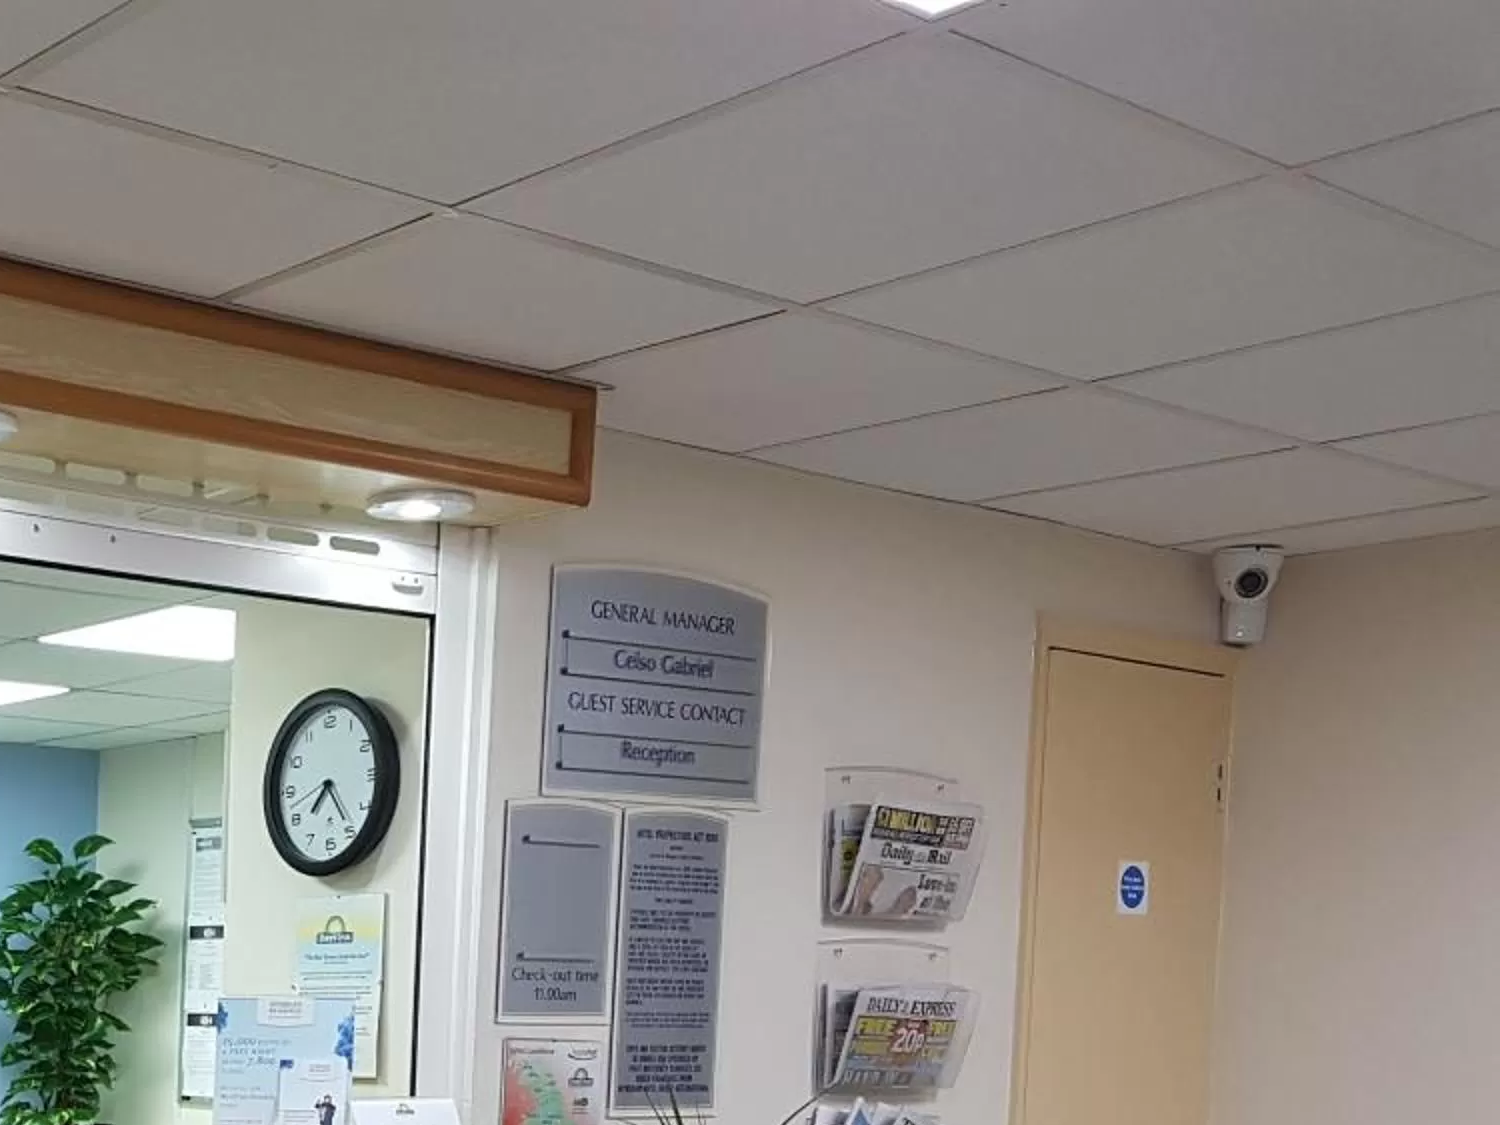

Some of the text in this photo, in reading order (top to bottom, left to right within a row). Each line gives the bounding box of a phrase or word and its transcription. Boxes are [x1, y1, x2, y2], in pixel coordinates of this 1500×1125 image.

[591, 600, 735, 635] GENERAL MANAGER
[660, 655, 714, 678] Gabriel
[568, 691, 746, 726] GUEST SERVICE CONTACT
[323, 715, 338, 729] 12
[621, 740, 696, 768] Reception
[881, 843, 914, 865] Daily
[511, 967, 599, 983] Check-out time
[867, 997, 957, 1017] DAILY EXPRESS
